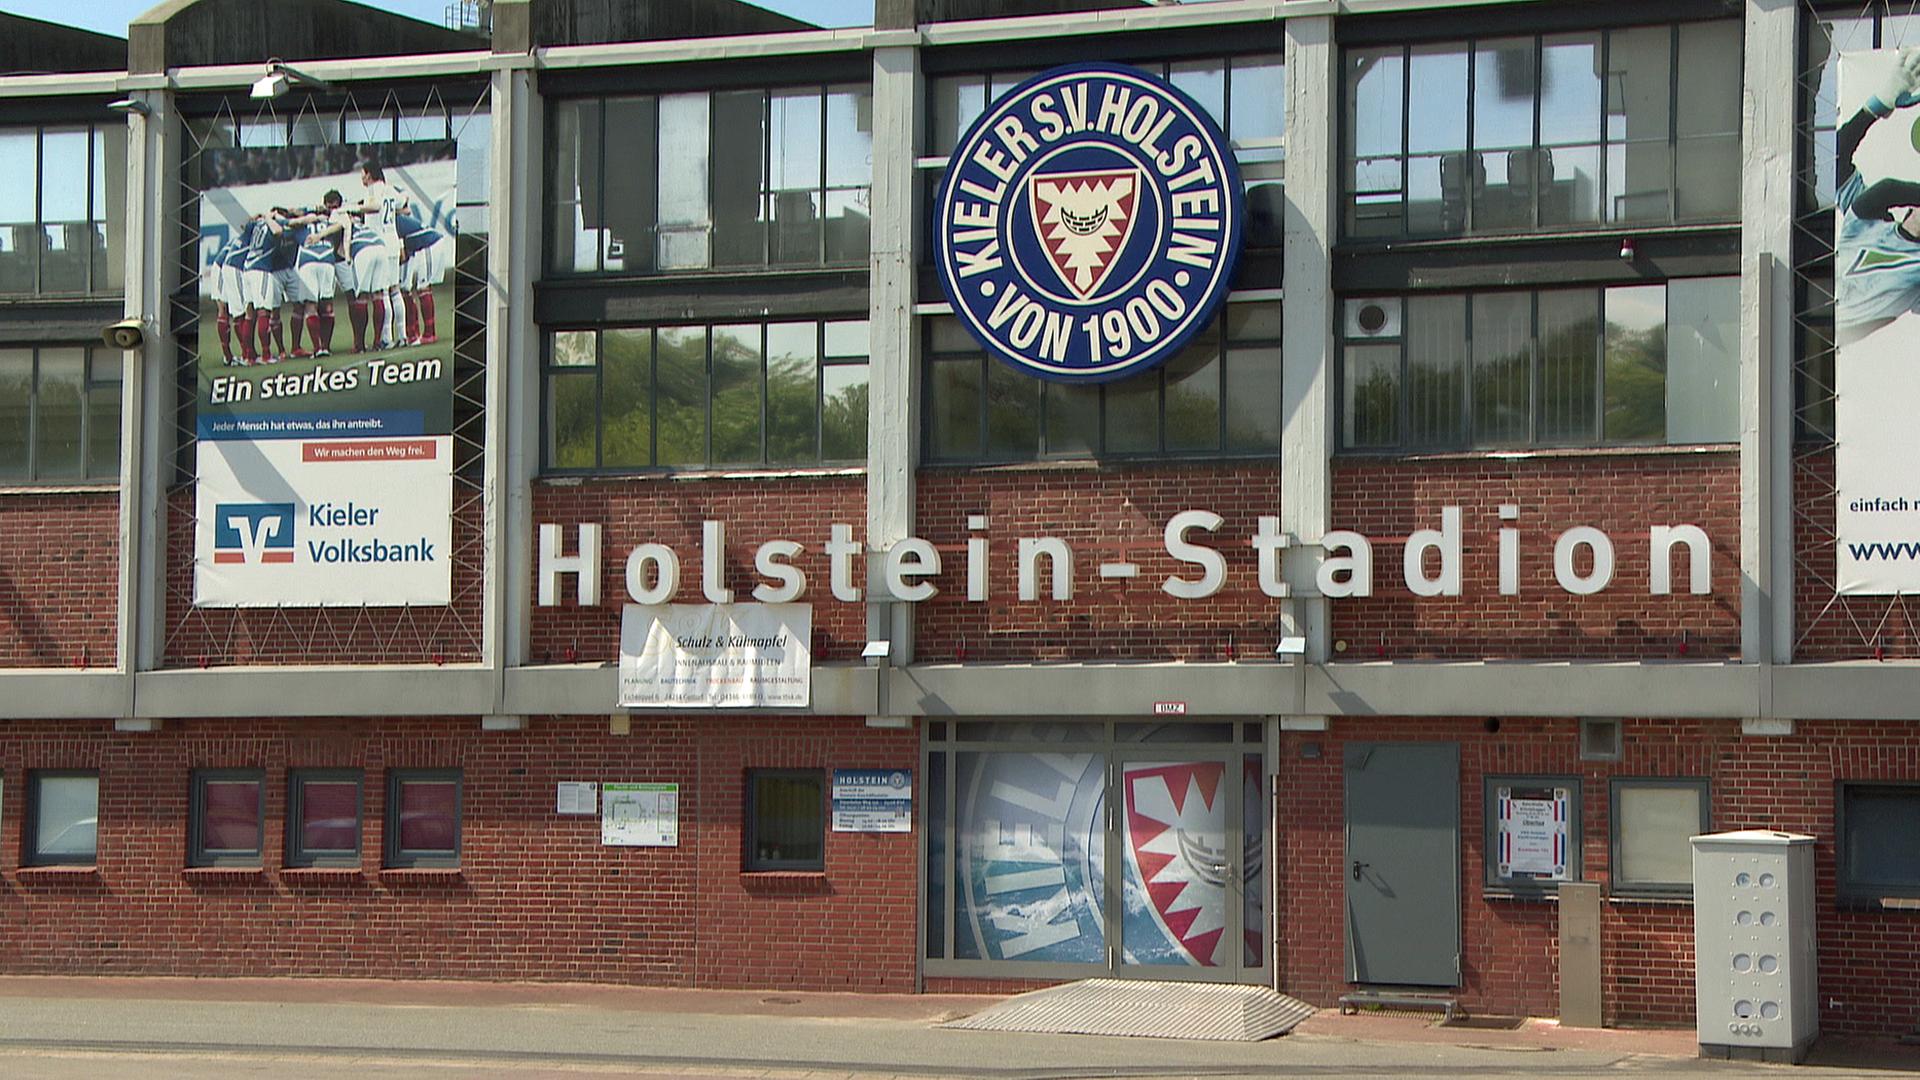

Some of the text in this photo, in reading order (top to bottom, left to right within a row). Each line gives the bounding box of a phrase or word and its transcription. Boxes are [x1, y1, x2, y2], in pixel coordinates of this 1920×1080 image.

[953, 116, 1040, 279] KIELER
[1096, 83, 1221, 270] HOLSTEIN
[986, 278, 1187, 363] VON 1900
[211, 357, 442, 404] Ein starkes Team
[213, 417, 384, 432] Jeder Mensch hat etwas, das ihn antreibt.
[314, 444, 425, 458] Wir machen den Weg frei.
[309, 502, 379, 527] Kieler
[1850, 496, 1908, 512] einfach
[307, 538, 434, 563] Volksbank
[676, 634, 788, 651] Schulz & Kühnapfel
[840, 776, 888, 785] HOLSTEIN
